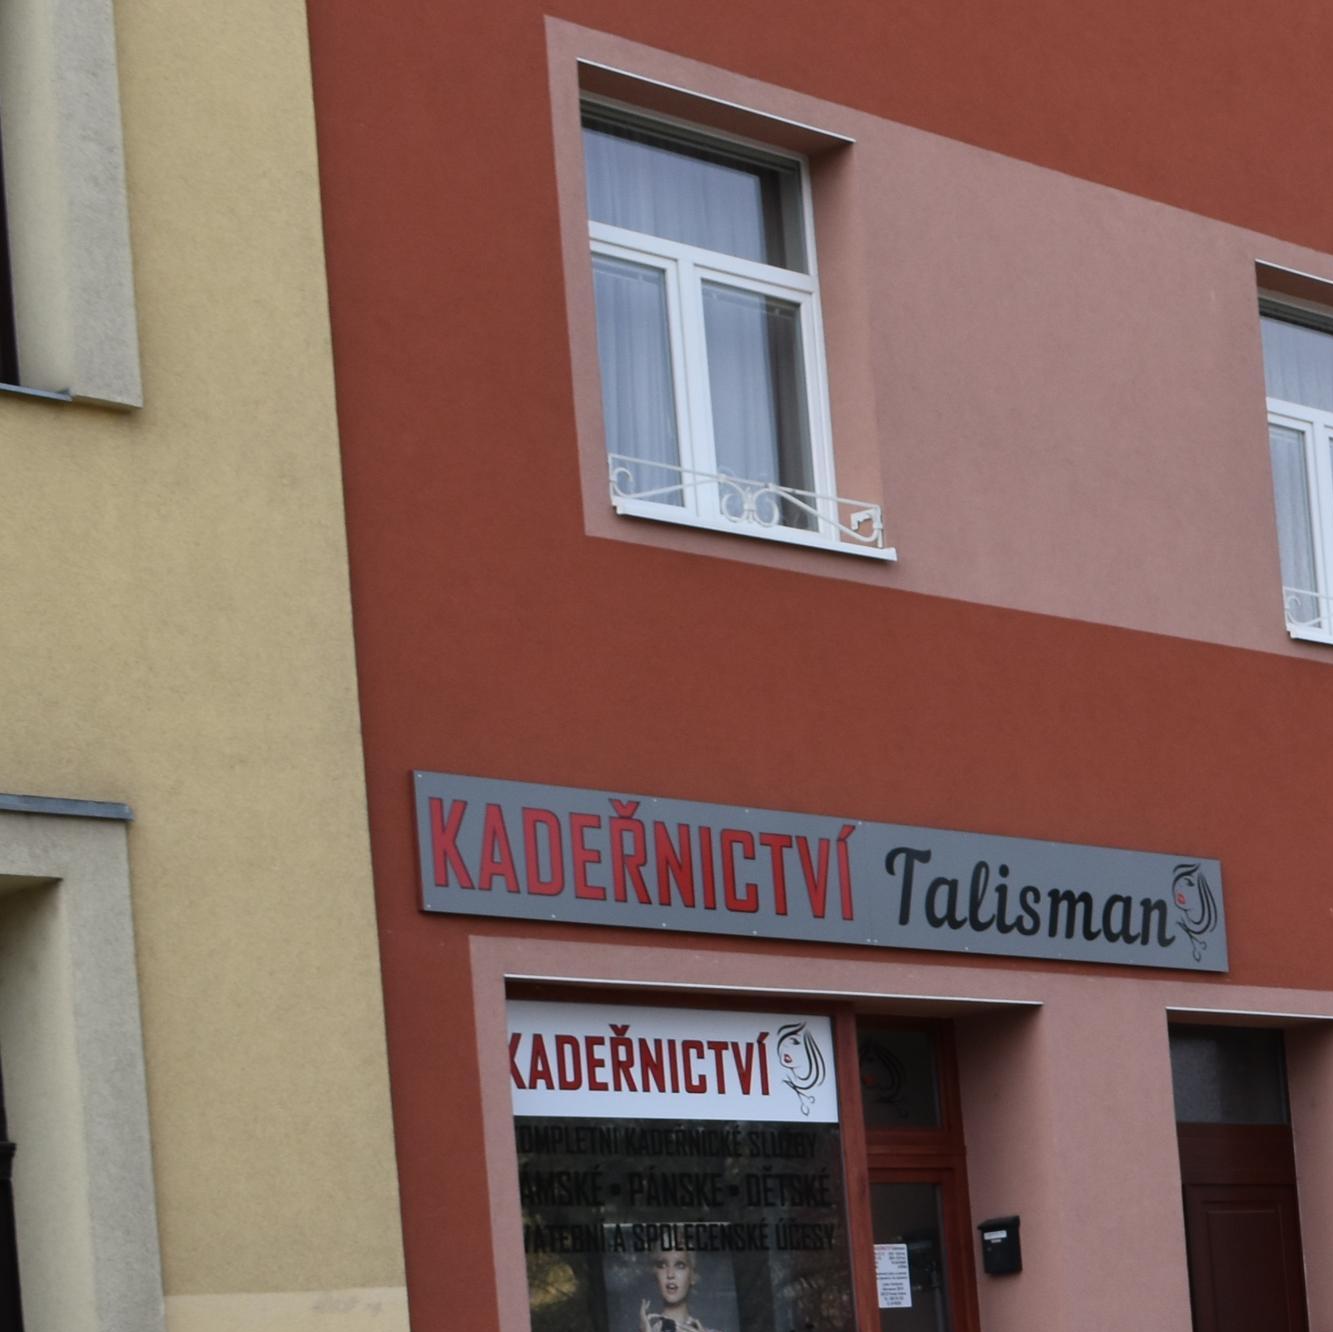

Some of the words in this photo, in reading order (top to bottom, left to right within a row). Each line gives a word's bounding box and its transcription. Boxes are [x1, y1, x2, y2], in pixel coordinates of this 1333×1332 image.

[427, 797, 856, 921] KADEŘNICTVÍ
[884, 846, 1175, 949] Talisman
[520, 1162, 605, 1207] ÁMSKÉ
